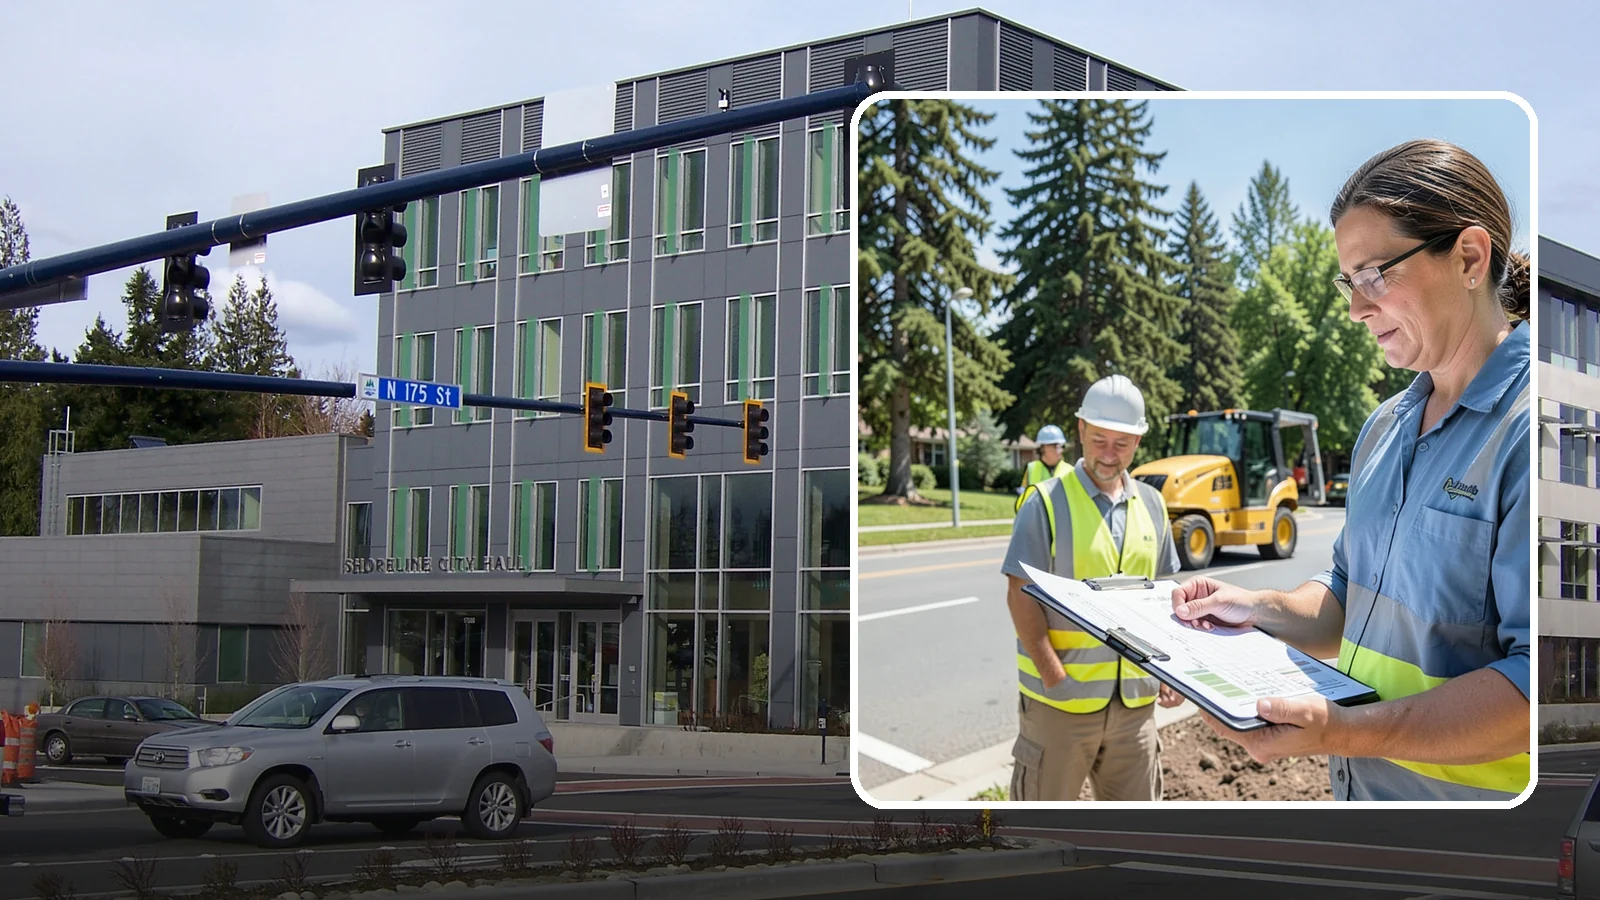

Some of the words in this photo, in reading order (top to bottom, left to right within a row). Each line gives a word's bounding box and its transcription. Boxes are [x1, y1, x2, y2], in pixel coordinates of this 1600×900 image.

[387, 380, 396, 400] N
[405, 382, 427, 403] 175
[436, 386, 451, 406] St
[344, 556, 432, 573] SHORELINE
[438, 556, 475, 572] CITY
[483, 555, 526, 571] HALL
